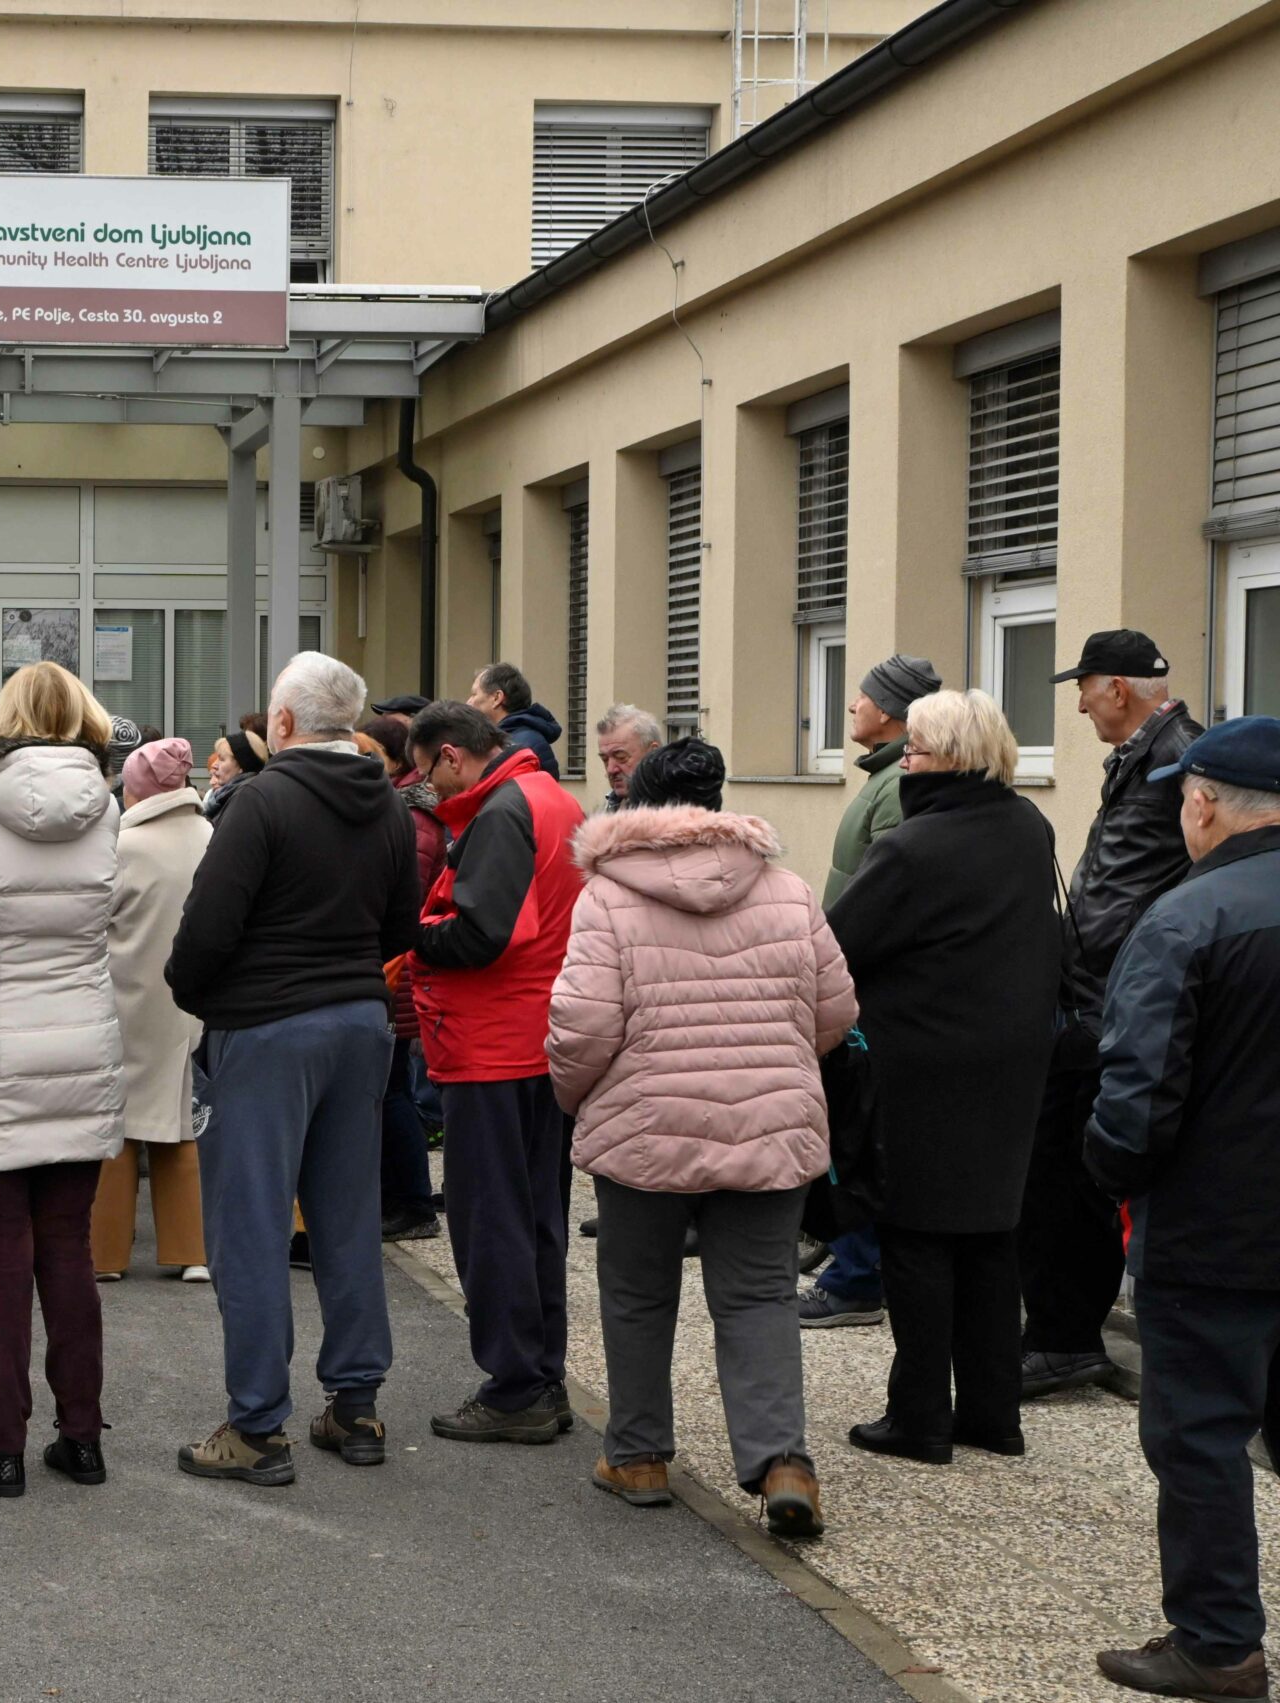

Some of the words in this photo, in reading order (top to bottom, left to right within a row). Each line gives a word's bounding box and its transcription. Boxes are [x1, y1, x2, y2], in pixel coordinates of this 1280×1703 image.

[93, 223, 144, 244] dom
[150, 224, 252, 247] Ljubljana
[53, 250, 109, 268] Health
[115, 252, 170, 270] Centre
[175, 253, 252, 273] Ljubljana
[12, 307, 31, 321] PE
[34, 307, 75, 325] Polje,
[78, 308, 120, 323] Cesta
[122, 309, 147, 323] 30.
[149, 310, 210, 327] avgusta
[212, 311, 223, 325] 2
